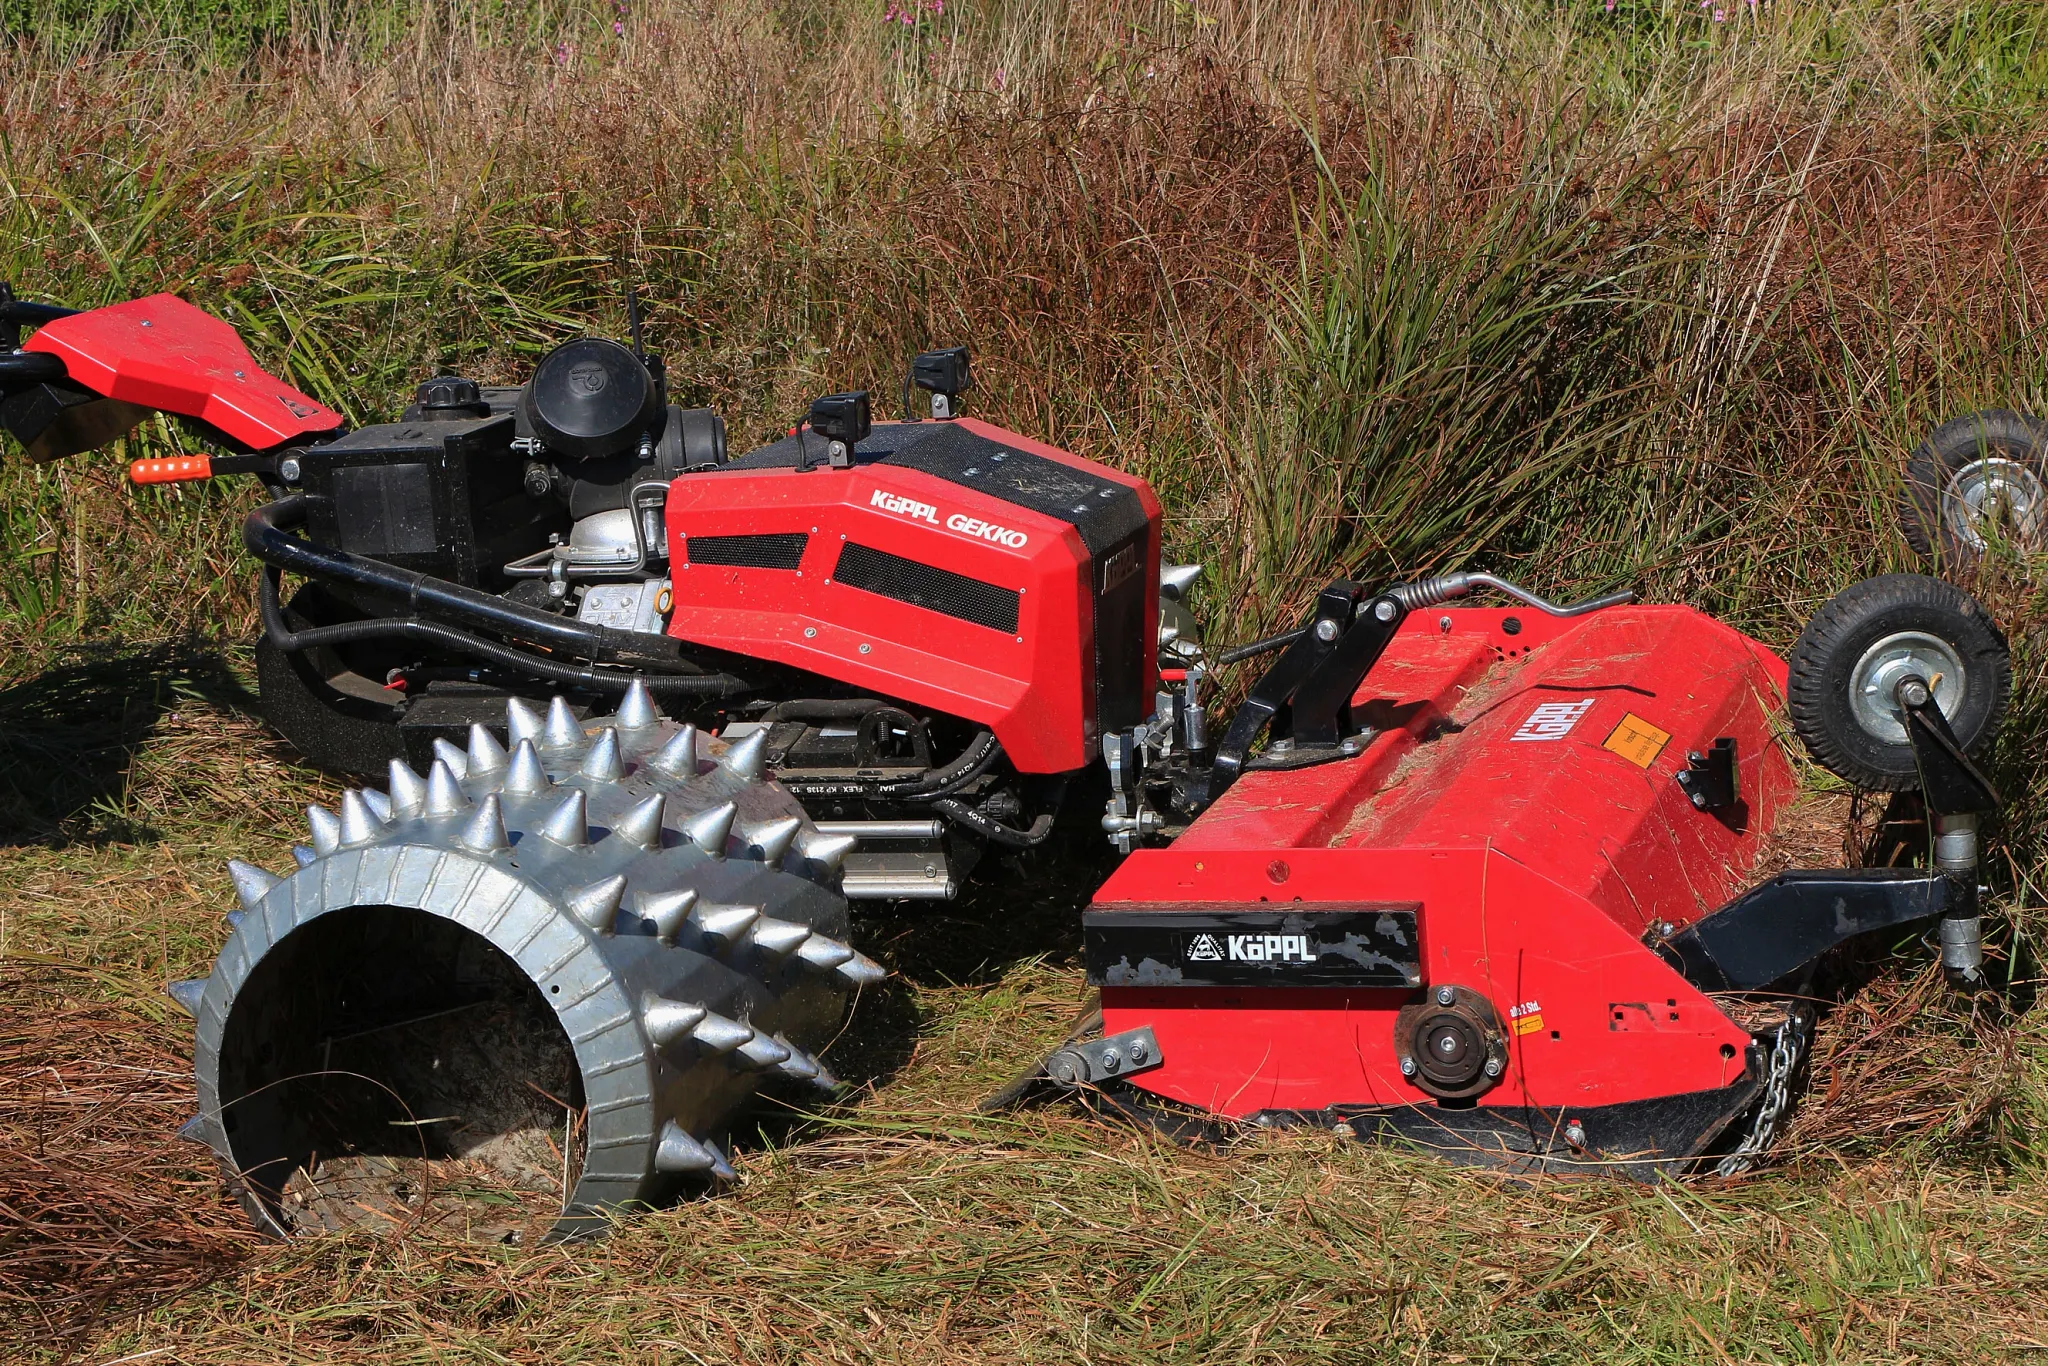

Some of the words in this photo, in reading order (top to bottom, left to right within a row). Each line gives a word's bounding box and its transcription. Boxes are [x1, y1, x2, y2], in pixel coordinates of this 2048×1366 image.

[946, 513, 1028, 548] GEKKO
[843, 785, 863, 793] FLEX
[967, 811, 986, 825] 4Q14
[1520, 1003, 1527, 1015] 2
[1526, 1000, 1542, 1013] Std.
